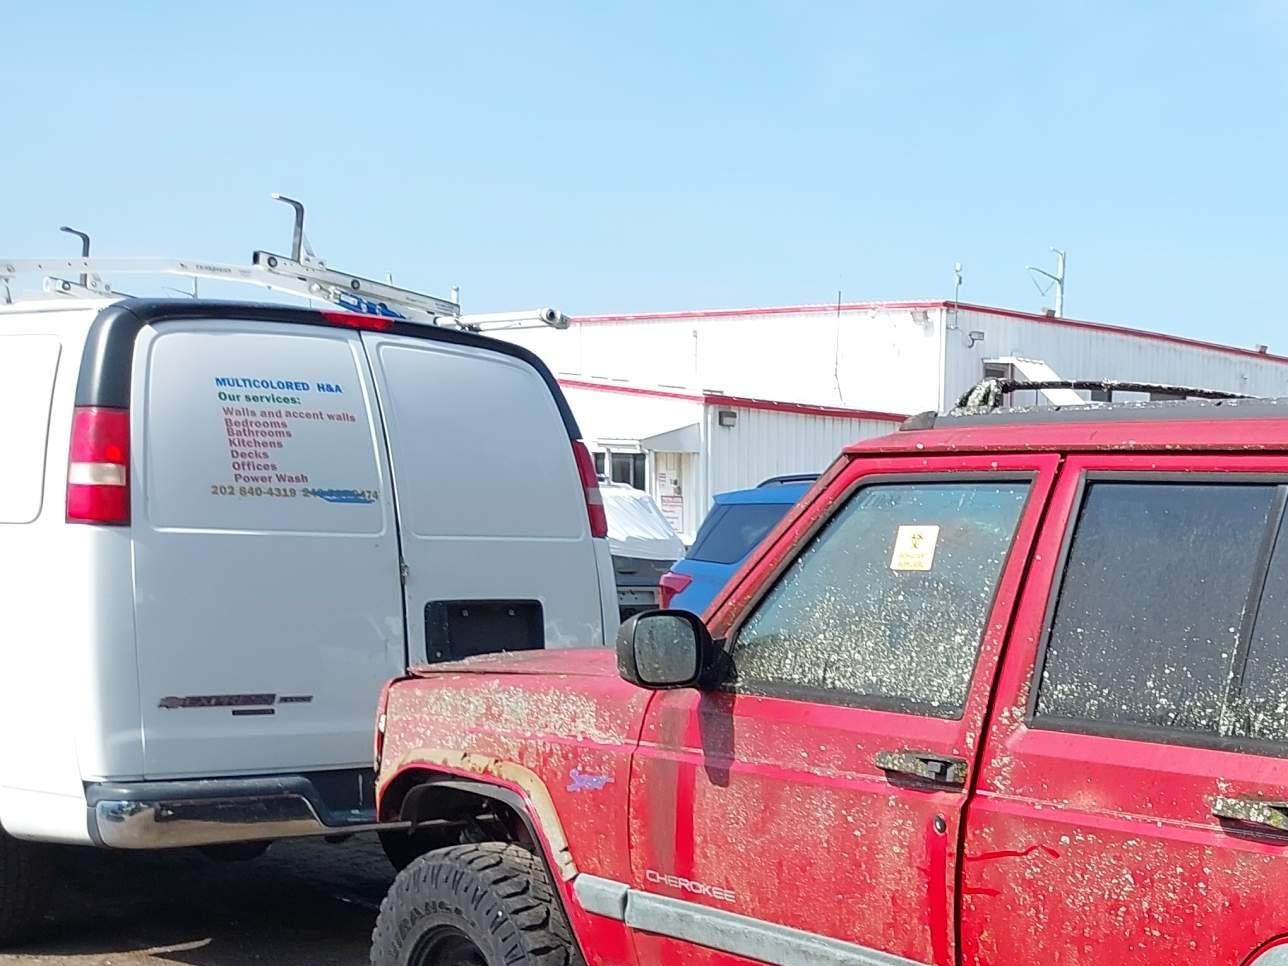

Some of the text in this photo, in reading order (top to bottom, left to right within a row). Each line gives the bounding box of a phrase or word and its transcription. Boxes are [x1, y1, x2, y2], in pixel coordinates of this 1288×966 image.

[215, 377, 343, 394] MULTICOLORED H&A
[218, 391, 302, 405] Our services:
[222, 407, 356, 422] Walls and accent walls
[224, 418, 288, 429] Bedrooms
[226, 427, 293, 438] Bathrooms
[228, 438, 284, 448] Kitchens
[231, 449, 269, 459] Decks
[232, 461, 278, 471] Offices
[234, 473, 309, 483] Power Wash
[211, 485, 236, 496] 202
[646, 869, 737, 903] CHEROKEE
